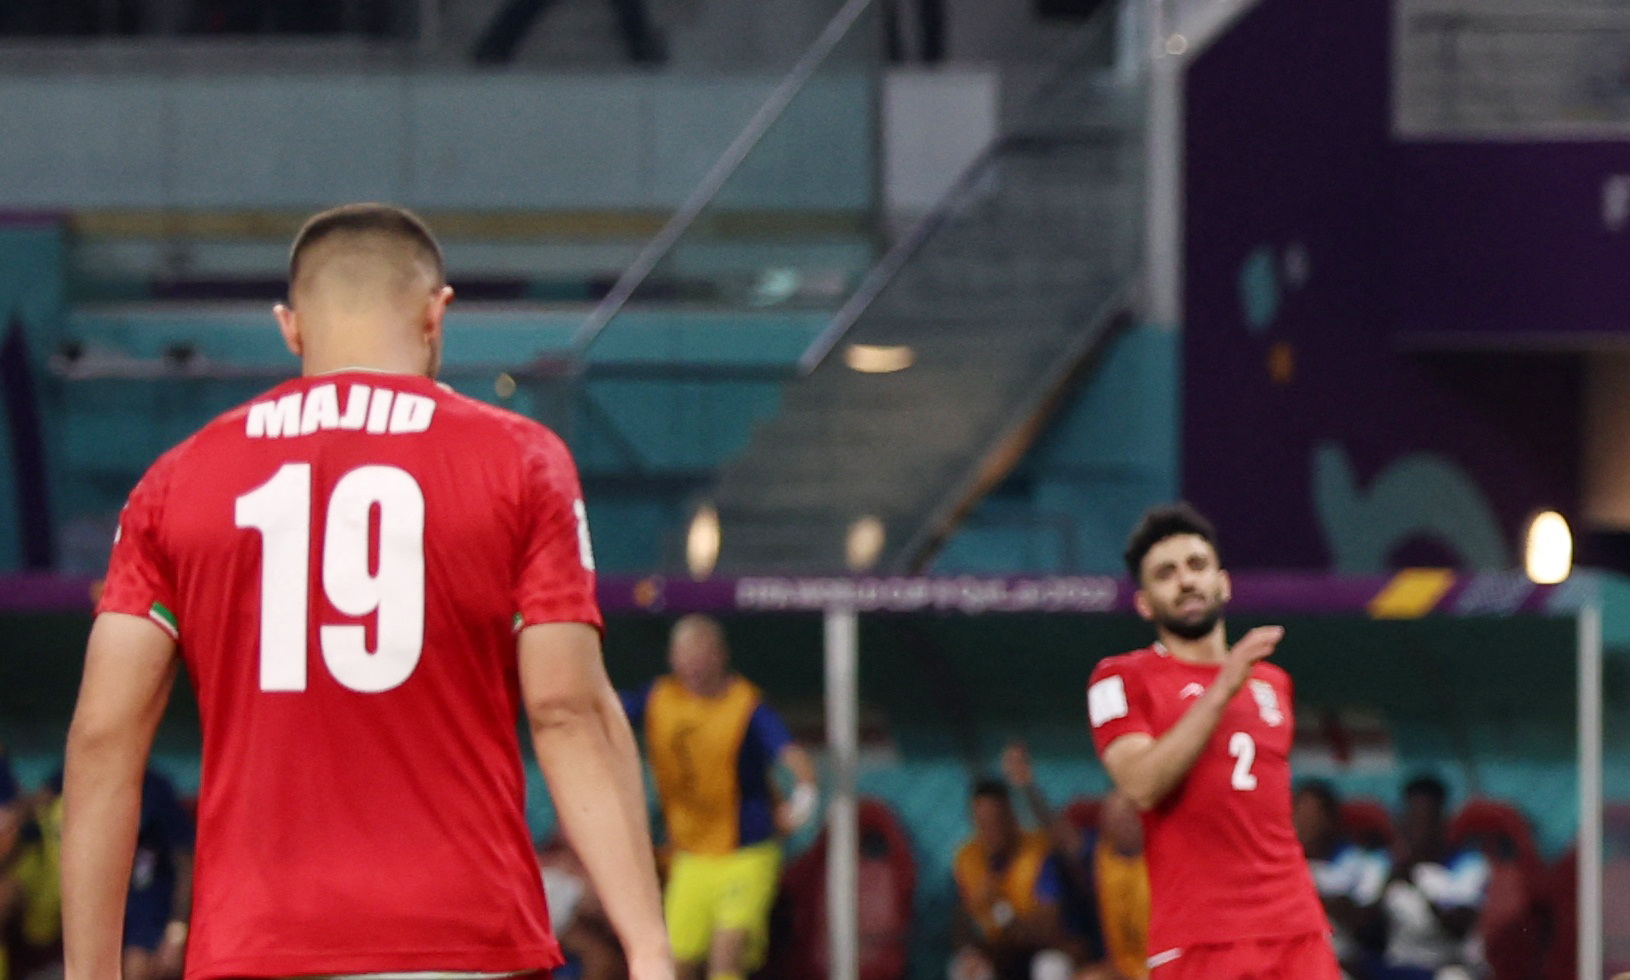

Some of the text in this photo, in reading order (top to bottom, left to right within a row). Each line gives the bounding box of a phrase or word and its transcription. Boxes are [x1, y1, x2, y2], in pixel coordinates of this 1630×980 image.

[246, 383, 437, 438] MAJID
[235, 462, 425, 694] 19
[1228, 731, 1257, 791] 2
